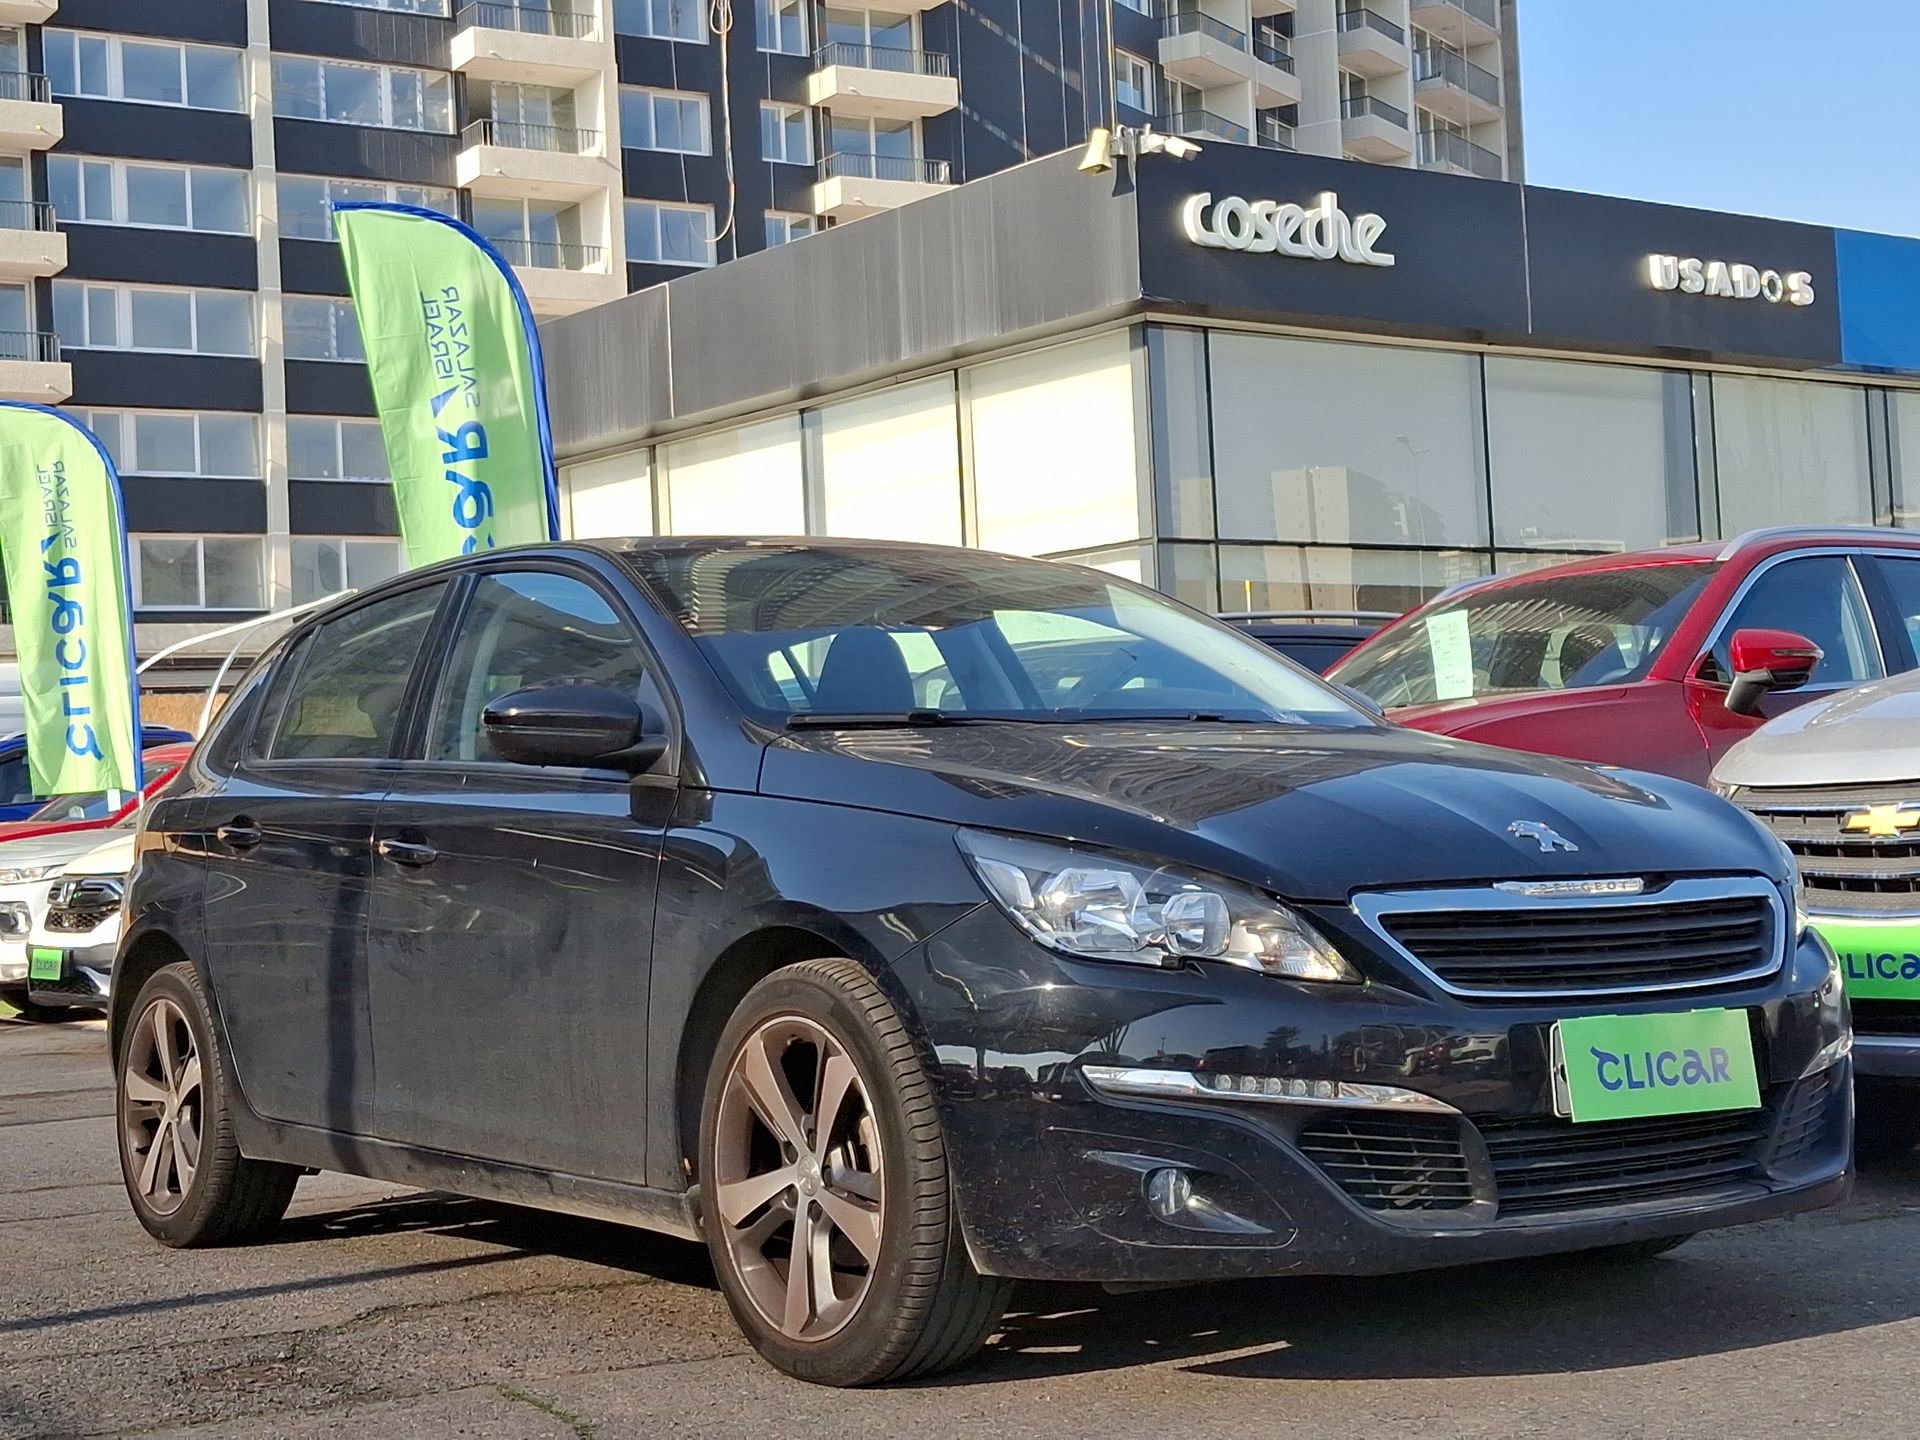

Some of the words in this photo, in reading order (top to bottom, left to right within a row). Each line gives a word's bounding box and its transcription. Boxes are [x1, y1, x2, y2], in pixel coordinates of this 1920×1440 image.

[1183, 191, 1395, 267] coseche
[1648, 254, 1815, 306] USADOS
[1838, 953, 1920, 980] LICa
